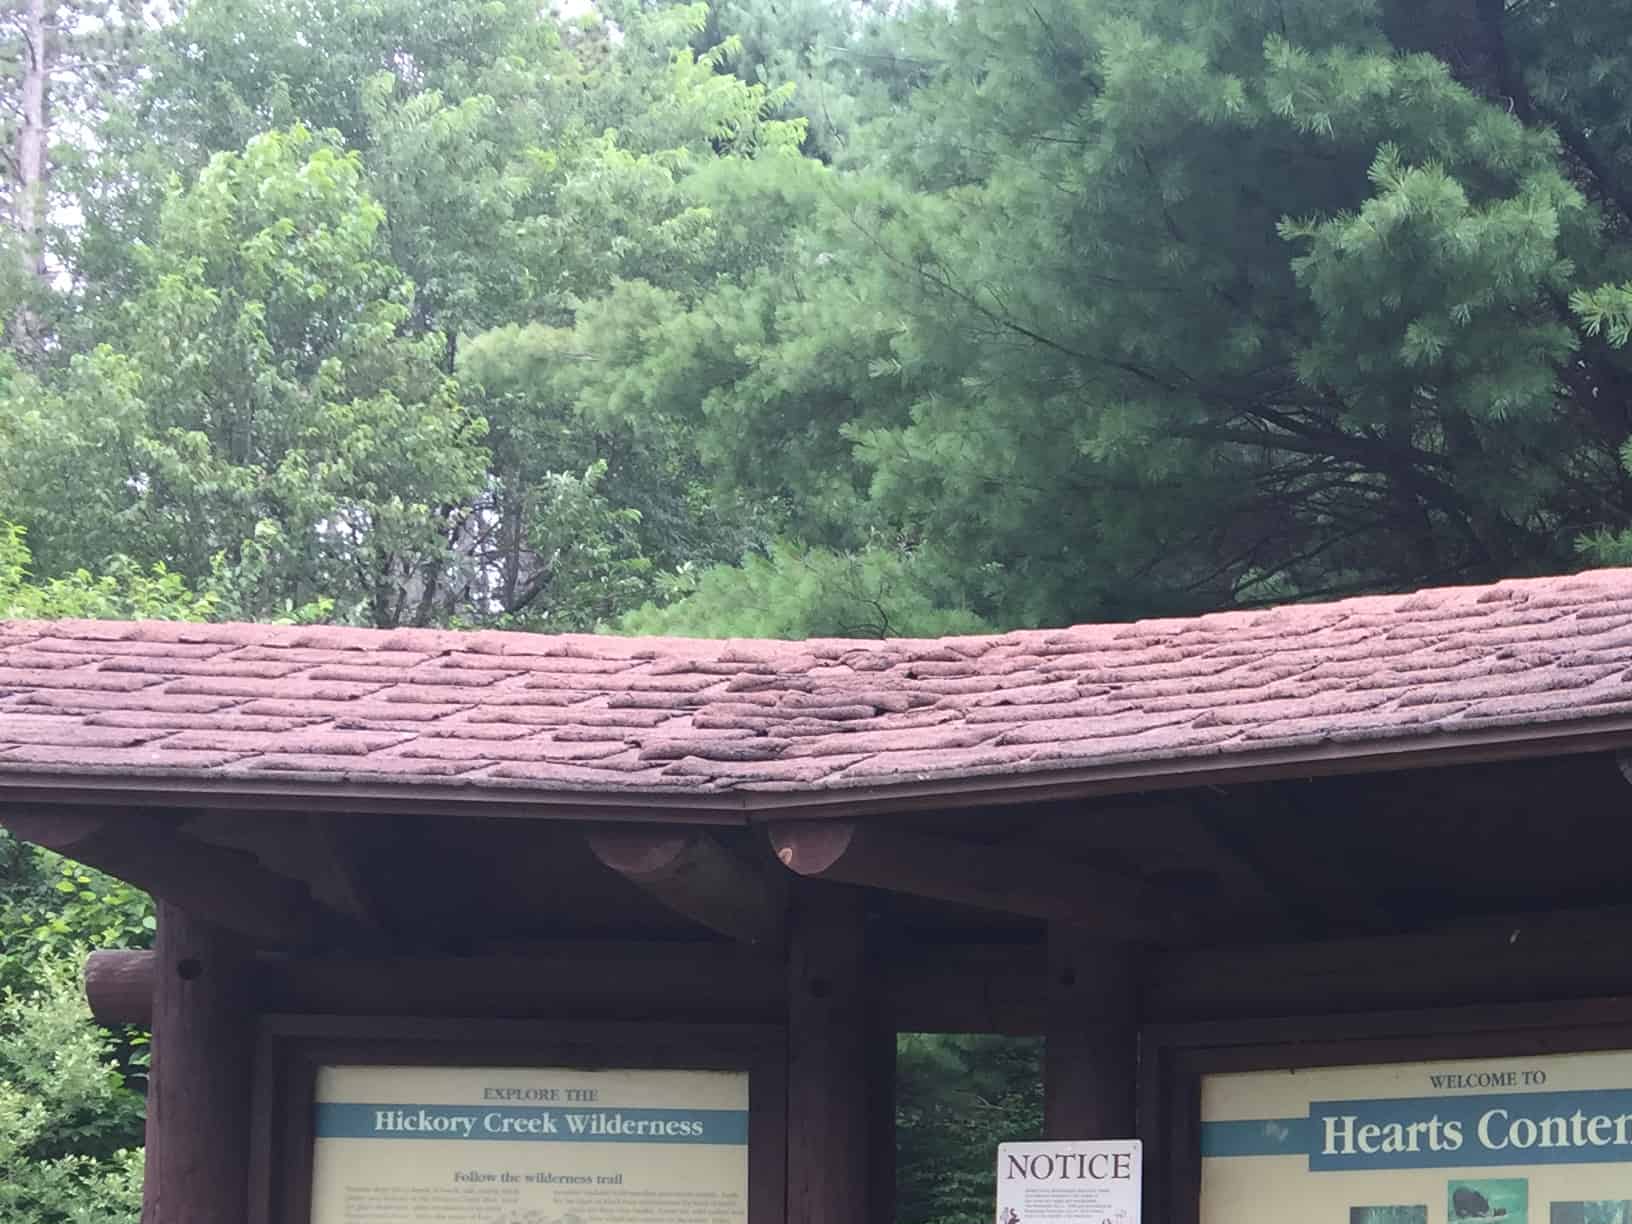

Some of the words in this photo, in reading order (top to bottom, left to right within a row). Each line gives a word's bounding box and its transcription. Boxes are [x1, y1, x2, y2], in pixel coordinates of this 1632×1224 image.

[1430, 1073, 1517, 1089] WELCOME
[1522, 1071, 1546, 1086] TO
[483, 1088, 560, 1102] EXPLORE
[566, 1088, 598, 1102] THE
[375, 1111, 476, 1137] Hickory
[484, 1112, 557, 1134] Creek
[564, 1114, 703, 1136] Wilderness
[1322, 1115, 1462, 1155] Hearts
[1007, 1153, 1131, 1180] NOTICE
[454, 1172, 494, 1184] Follow
[500, 1172, 520, 1184] the
[525, 1172, 592, 1185] wilderness
[596, 1174, 622, 1185] trail
